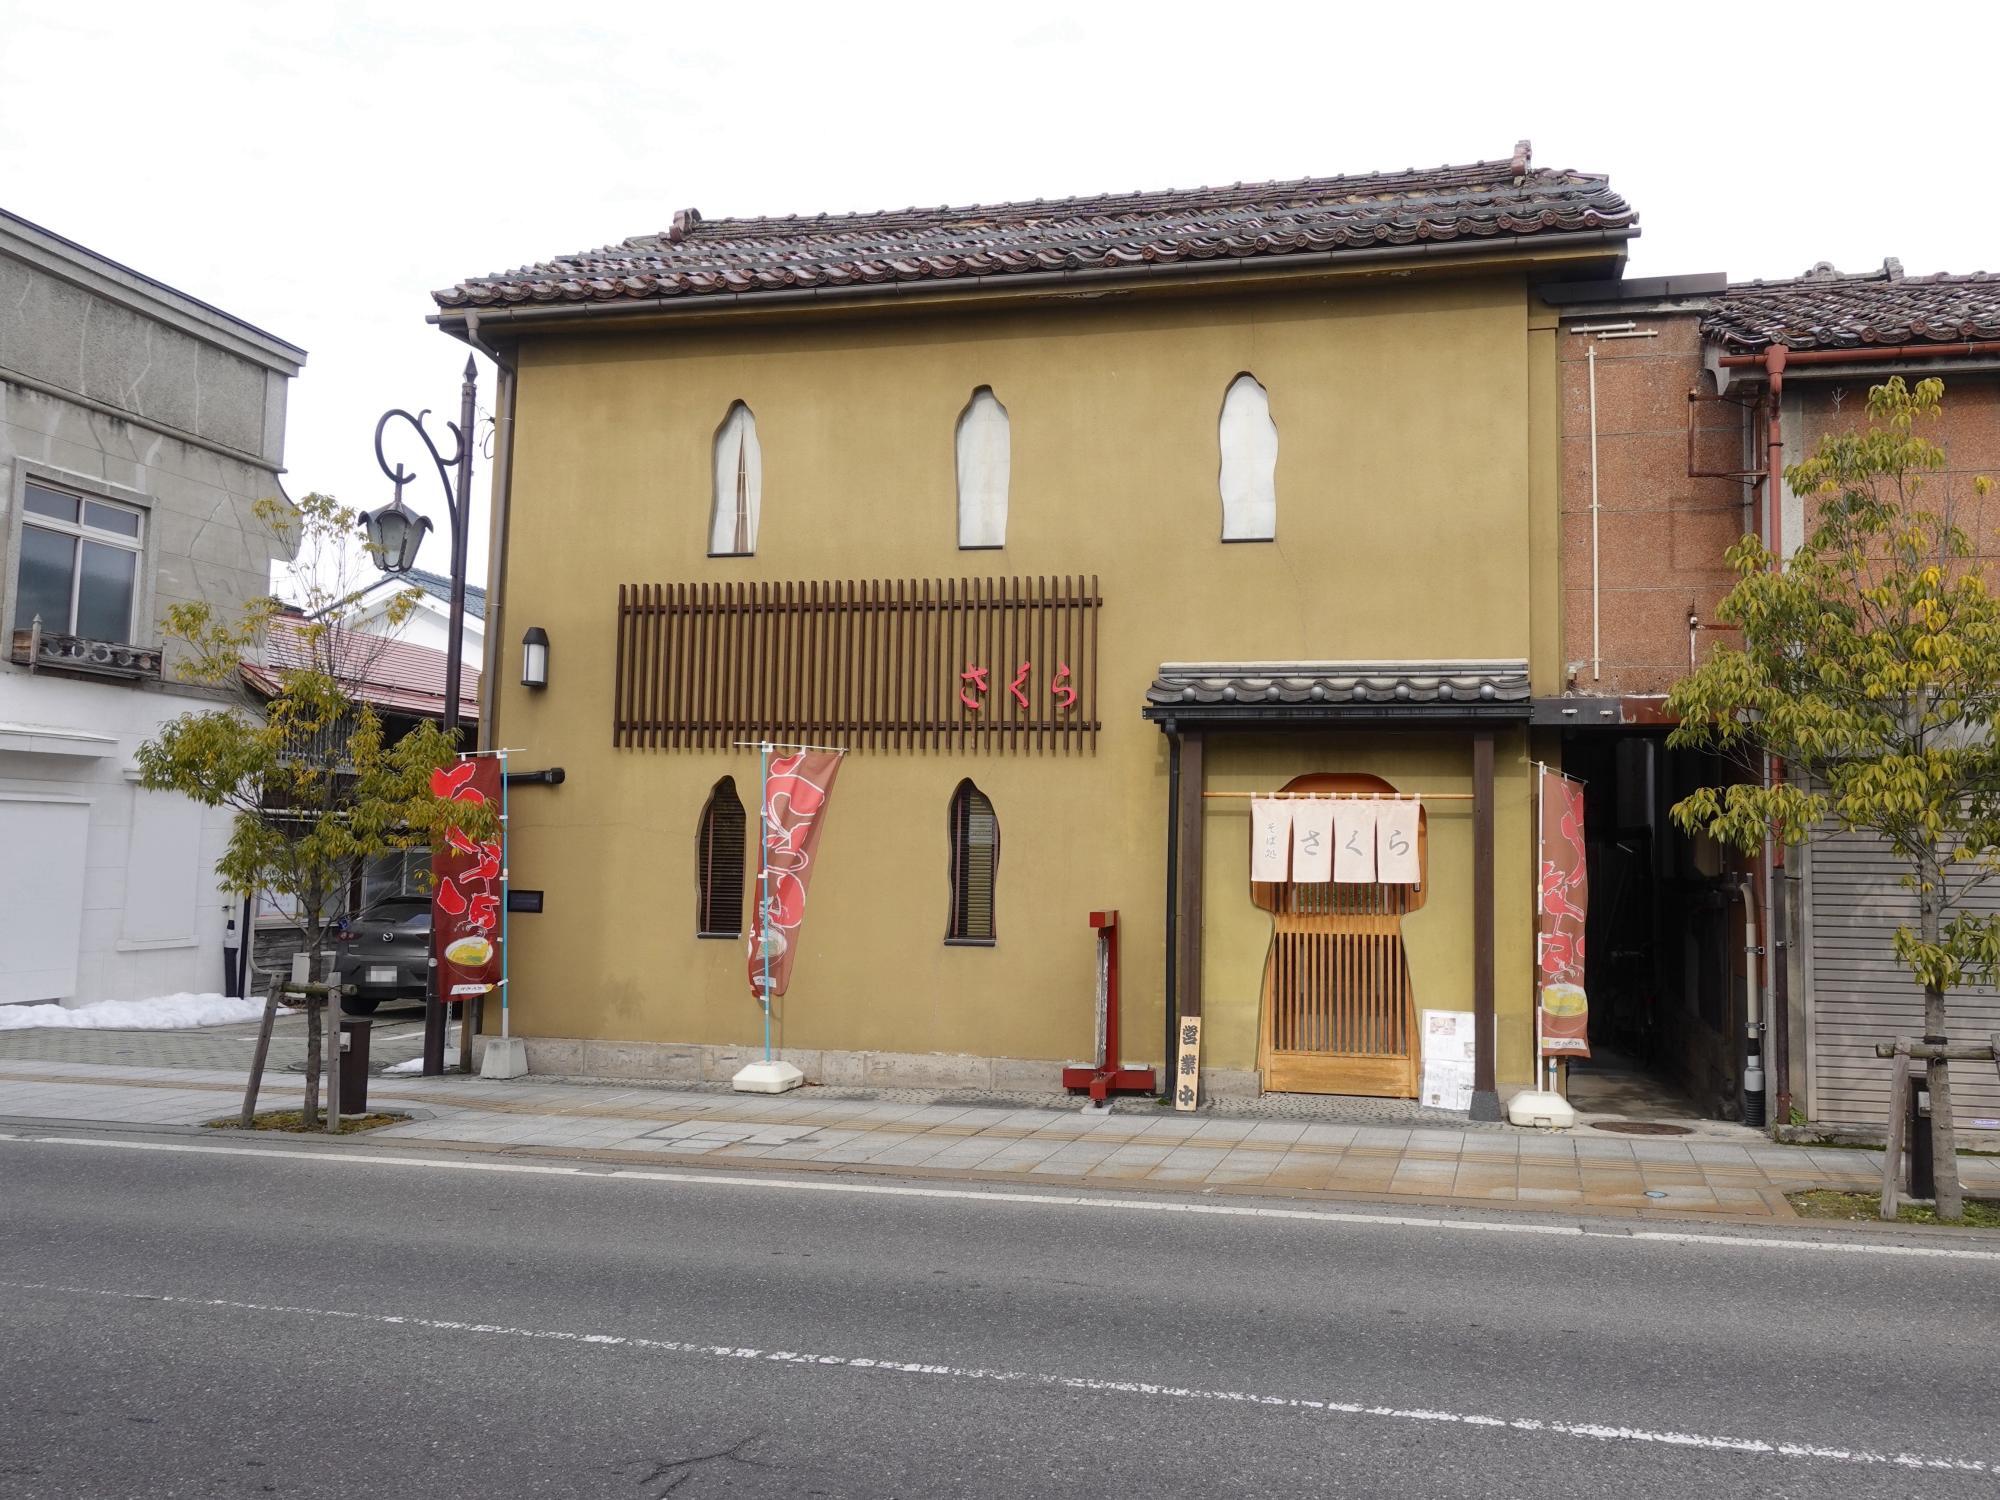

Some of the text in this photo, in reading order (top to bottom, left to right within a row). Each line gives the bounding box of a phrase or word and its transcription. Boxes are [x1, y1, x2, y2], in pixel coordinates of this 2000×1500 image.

[960, 661, 1077, 709] さくら
[1264, 822, 1278, 859] そば処
[1301, 830, 1409, 856] さくら
[1178, 1024, 1198, 1106] 営業中
